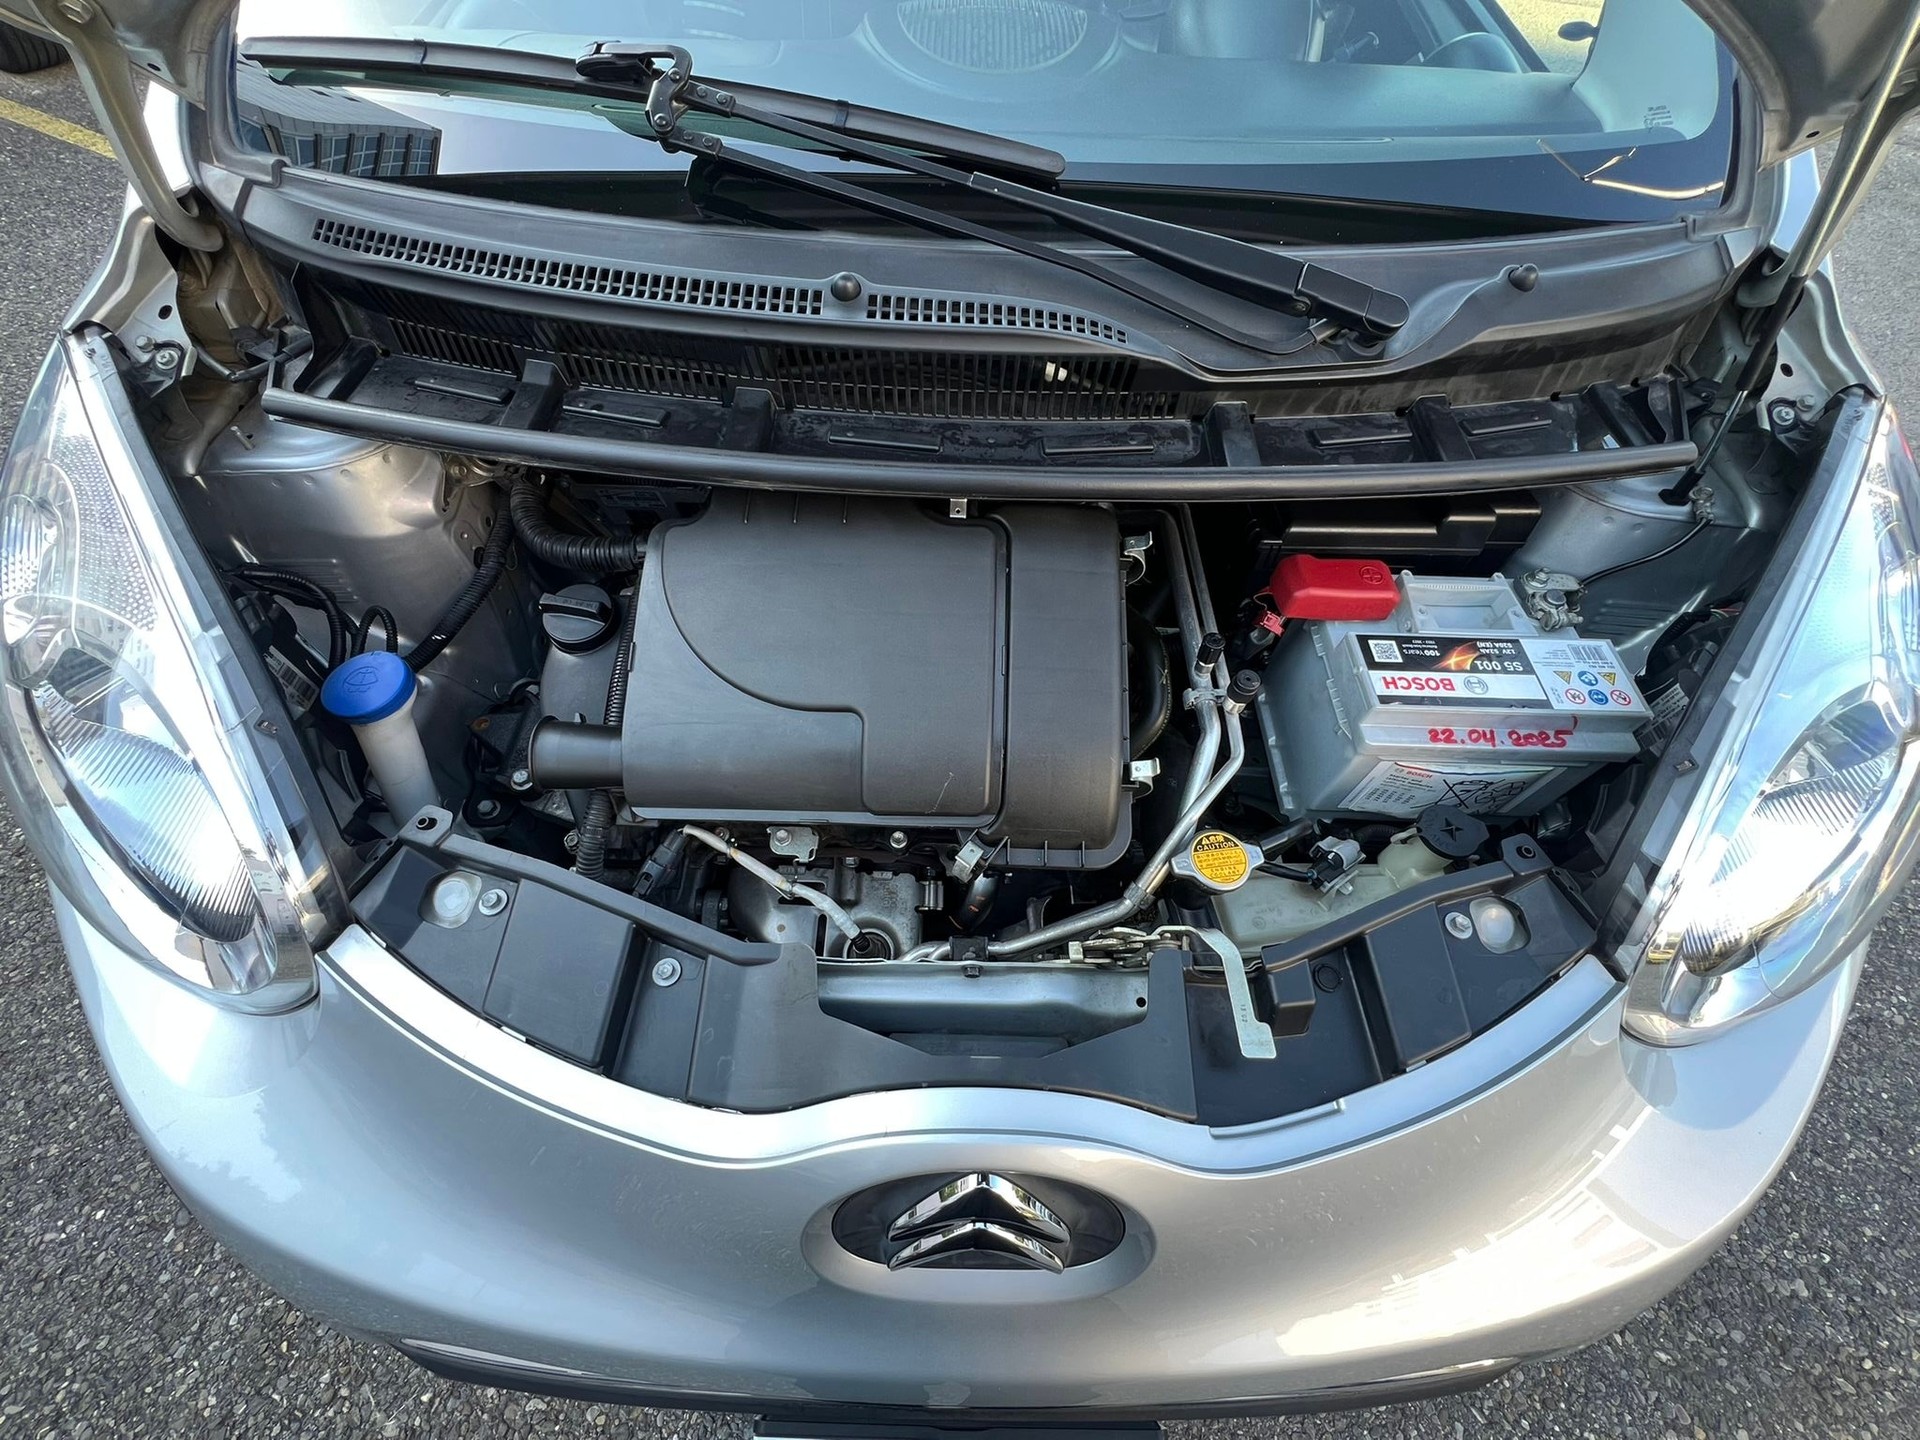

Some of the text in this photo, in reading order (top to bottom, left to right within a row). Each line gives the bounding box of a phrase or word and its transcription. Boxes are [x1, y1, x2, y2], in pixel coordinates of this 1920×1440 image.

[1474, 660, 1501, 671] 001
[1503, 661, 1523, 671] S5
[1382, 676, 1455, 691] BOSCH
[1197, 841, 1235, 851] CAUTION
